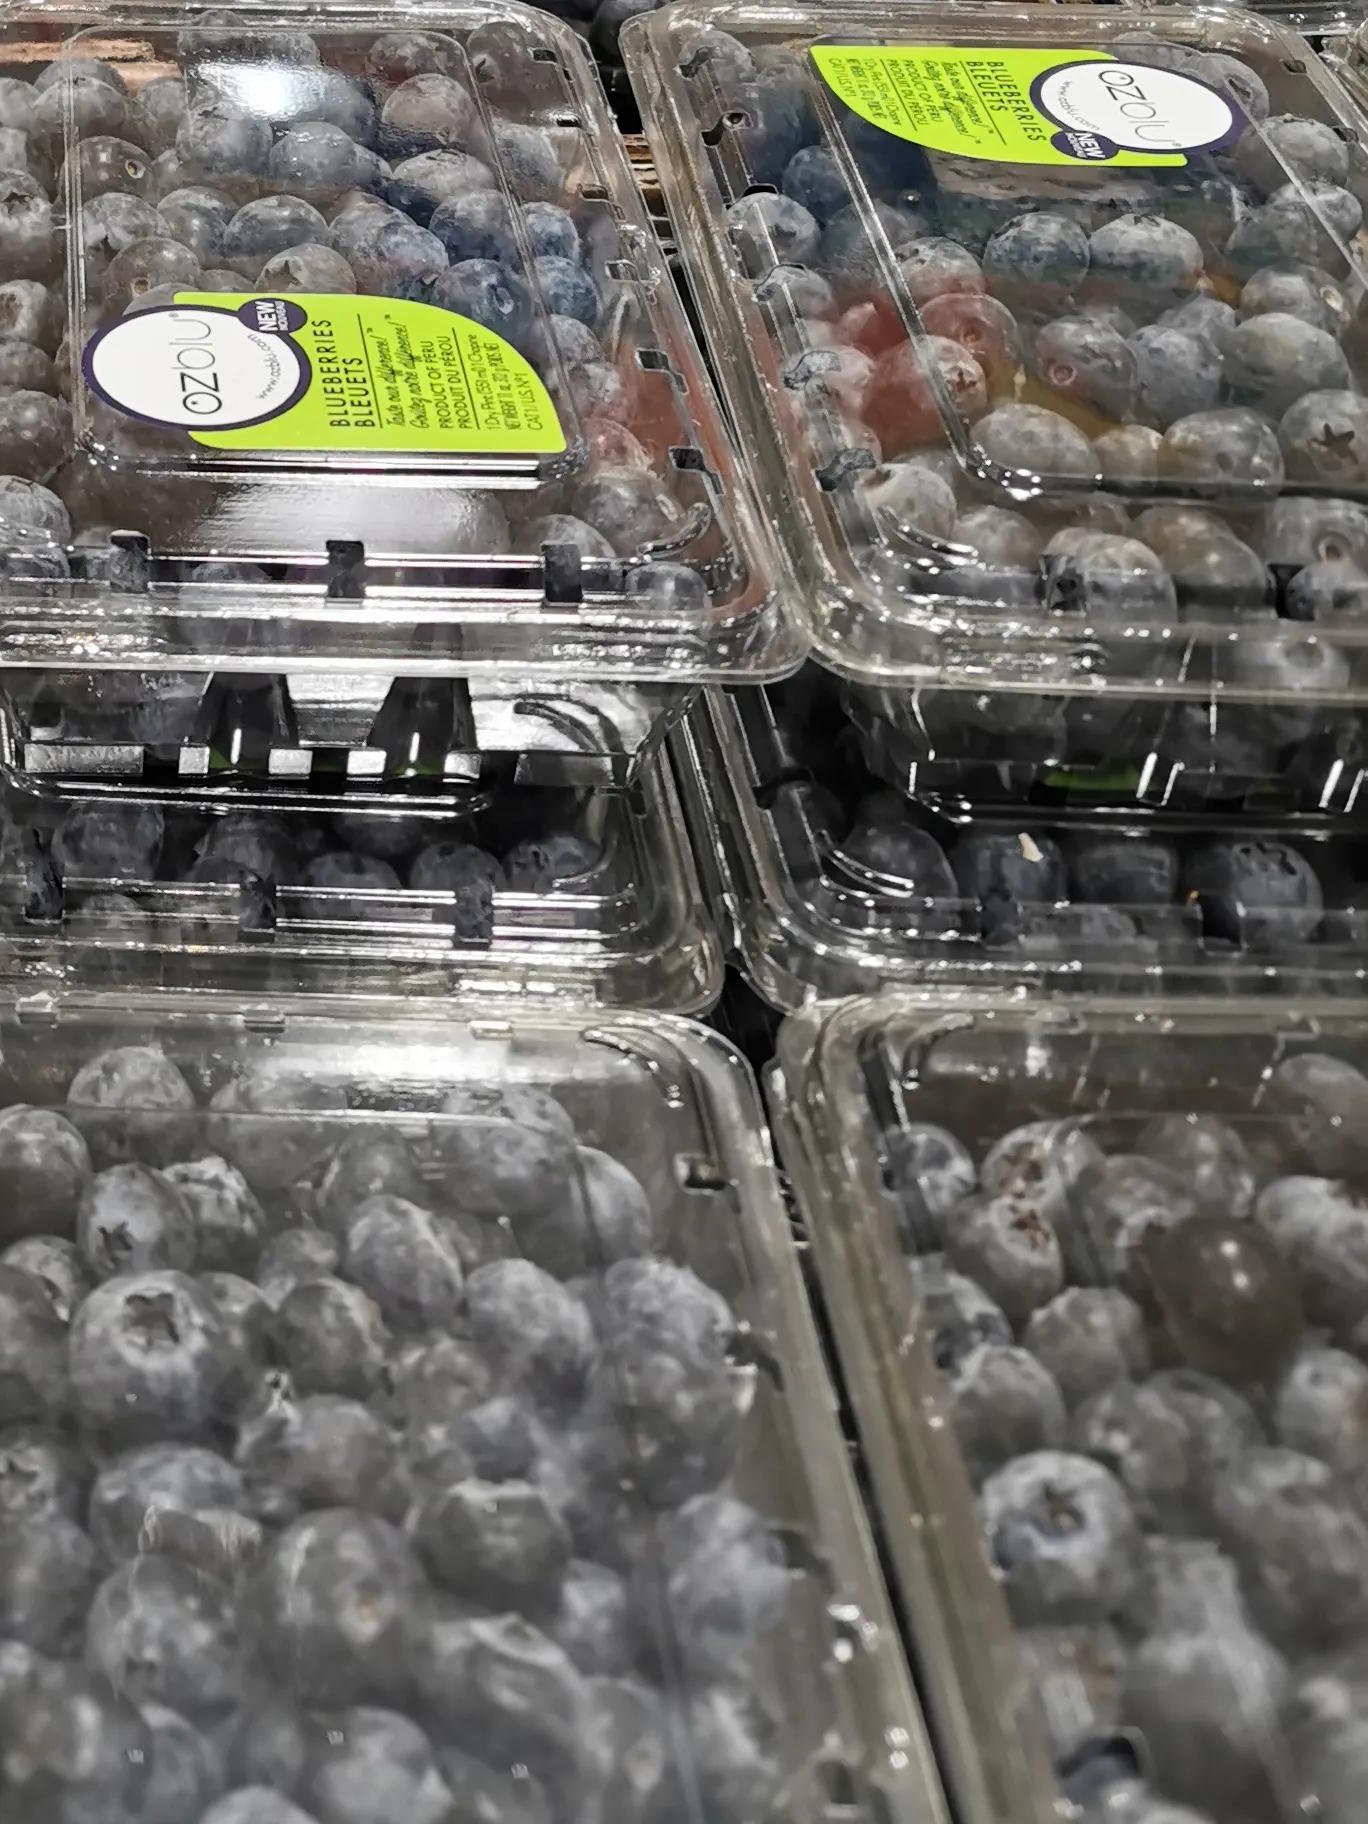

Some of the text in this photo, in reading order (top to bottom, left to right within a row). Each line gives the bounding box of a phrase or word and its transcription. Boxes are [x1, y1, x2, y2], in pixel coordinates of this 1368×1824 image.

[966, 61, 1008, 112] BLEUETS
[986, 61, 1047, 141] BLUEBERRIES
[255, 301, 278, 332] NEW
[312, 319, 351, 427] BLUEBERRIES
[342, 357, 376, 427] BLEUETS
[419, 340, 454, 429] PRODUCT OF PERU
[445, 369, 462, 384] DU
[449, 386, 472, 429] PRODUIT
